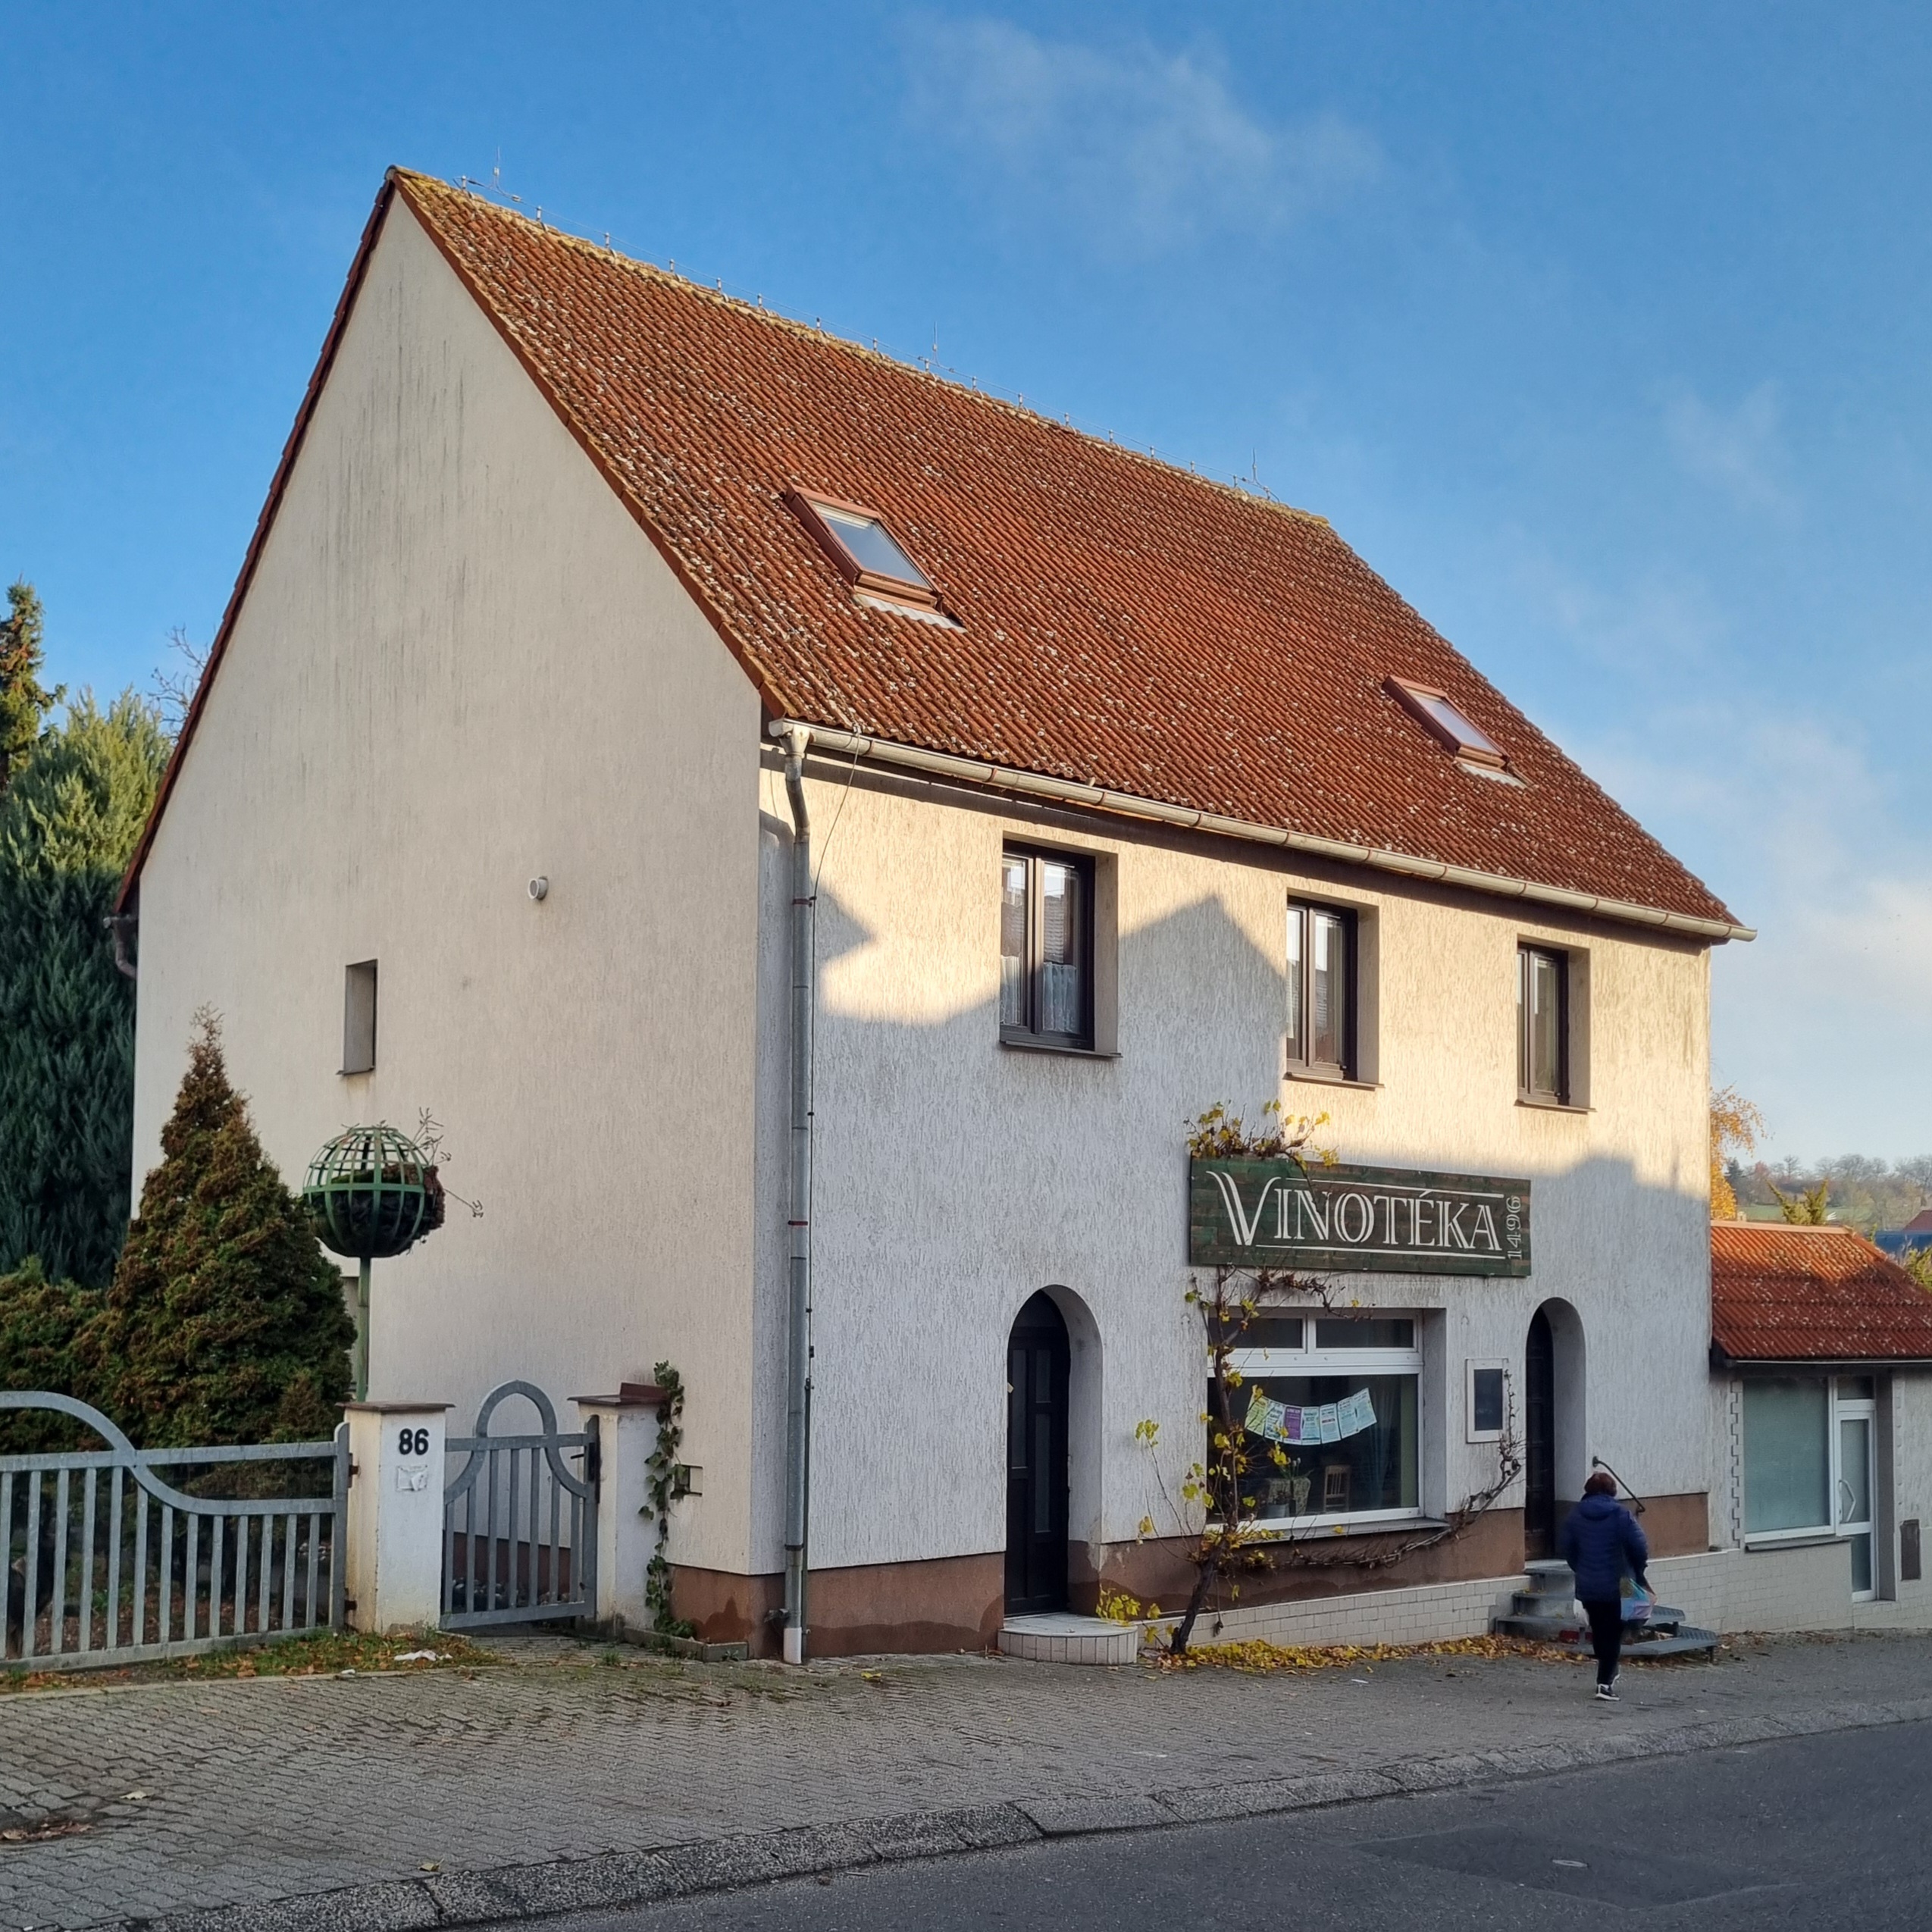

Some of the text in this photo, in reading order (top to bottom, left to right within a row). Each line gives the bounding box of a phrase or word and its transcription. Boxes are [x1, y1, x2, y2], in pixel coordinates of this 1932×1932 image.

[1206, 1171, 1502, 1251] VINOTÉKA
[1506, 1195, 1522, 1260] 1496
[399, 1428, 429, 1456] 86
